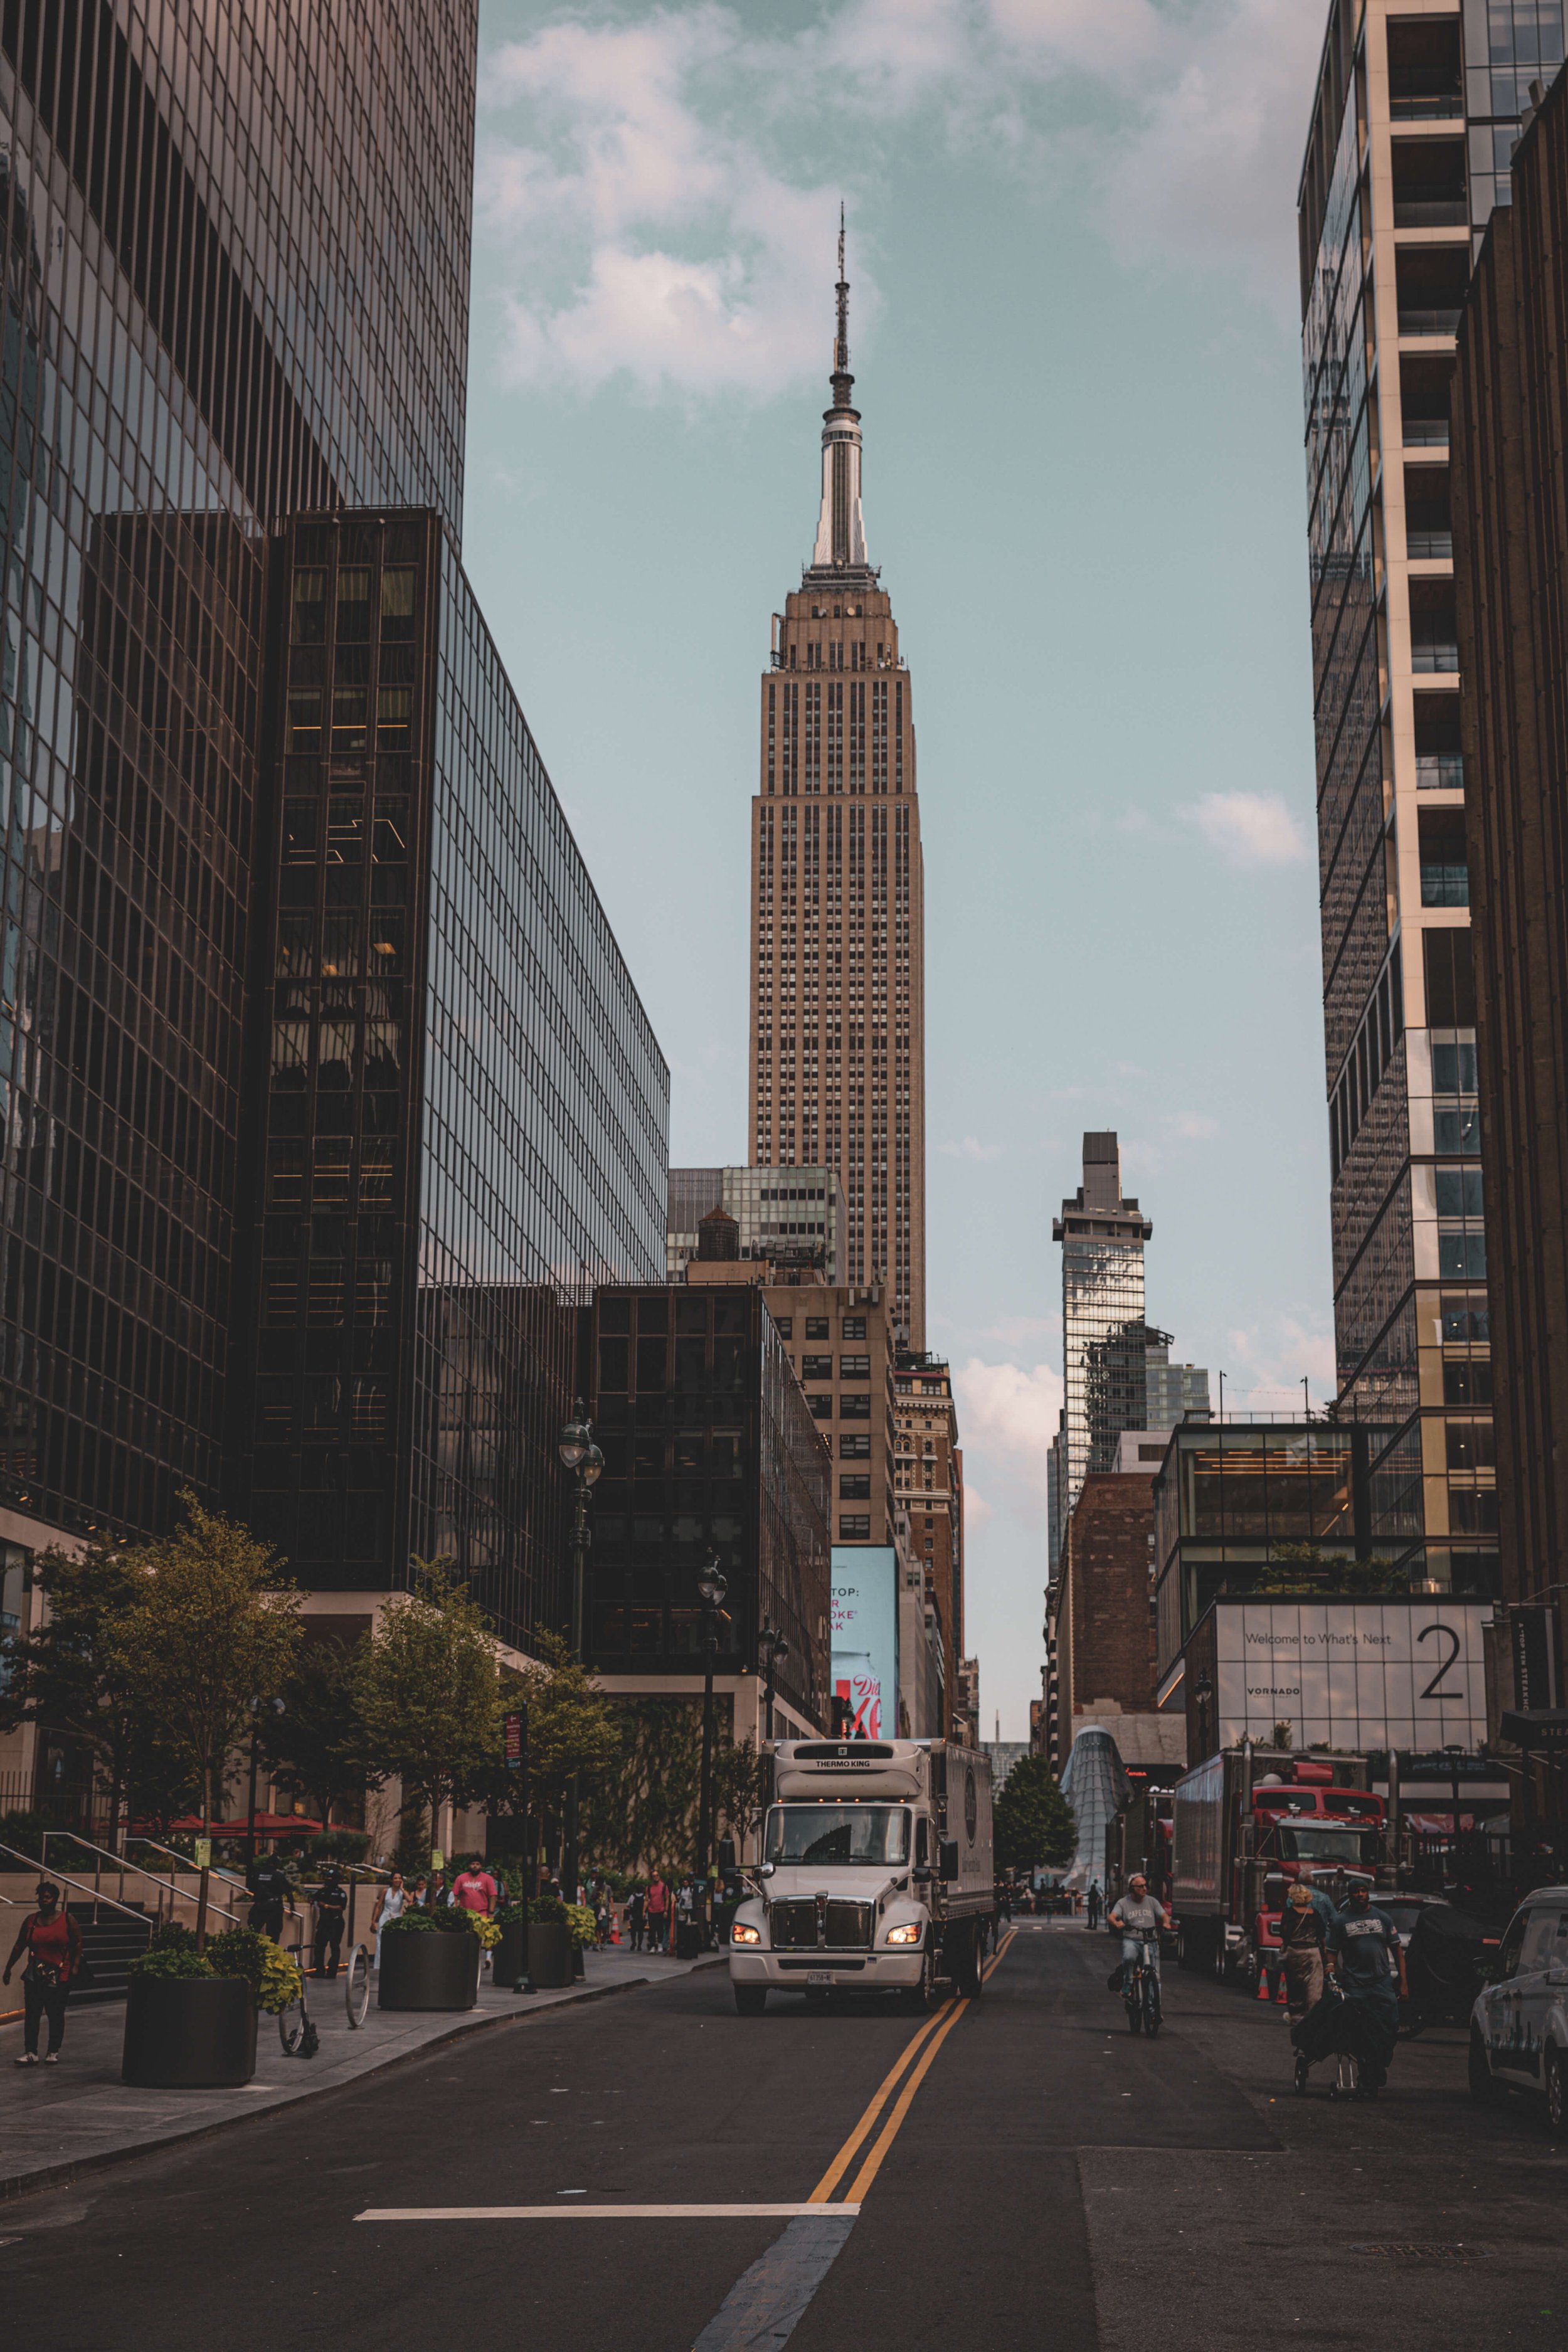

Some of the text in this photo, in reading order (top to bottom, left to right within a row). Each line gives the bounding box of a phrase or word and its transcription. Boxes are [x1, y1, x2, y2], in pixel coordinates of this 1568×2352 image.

[1246, 1633, 1392, 1645] Welcome to What's Next
[1417, 1624, 1463, 1698] 2
